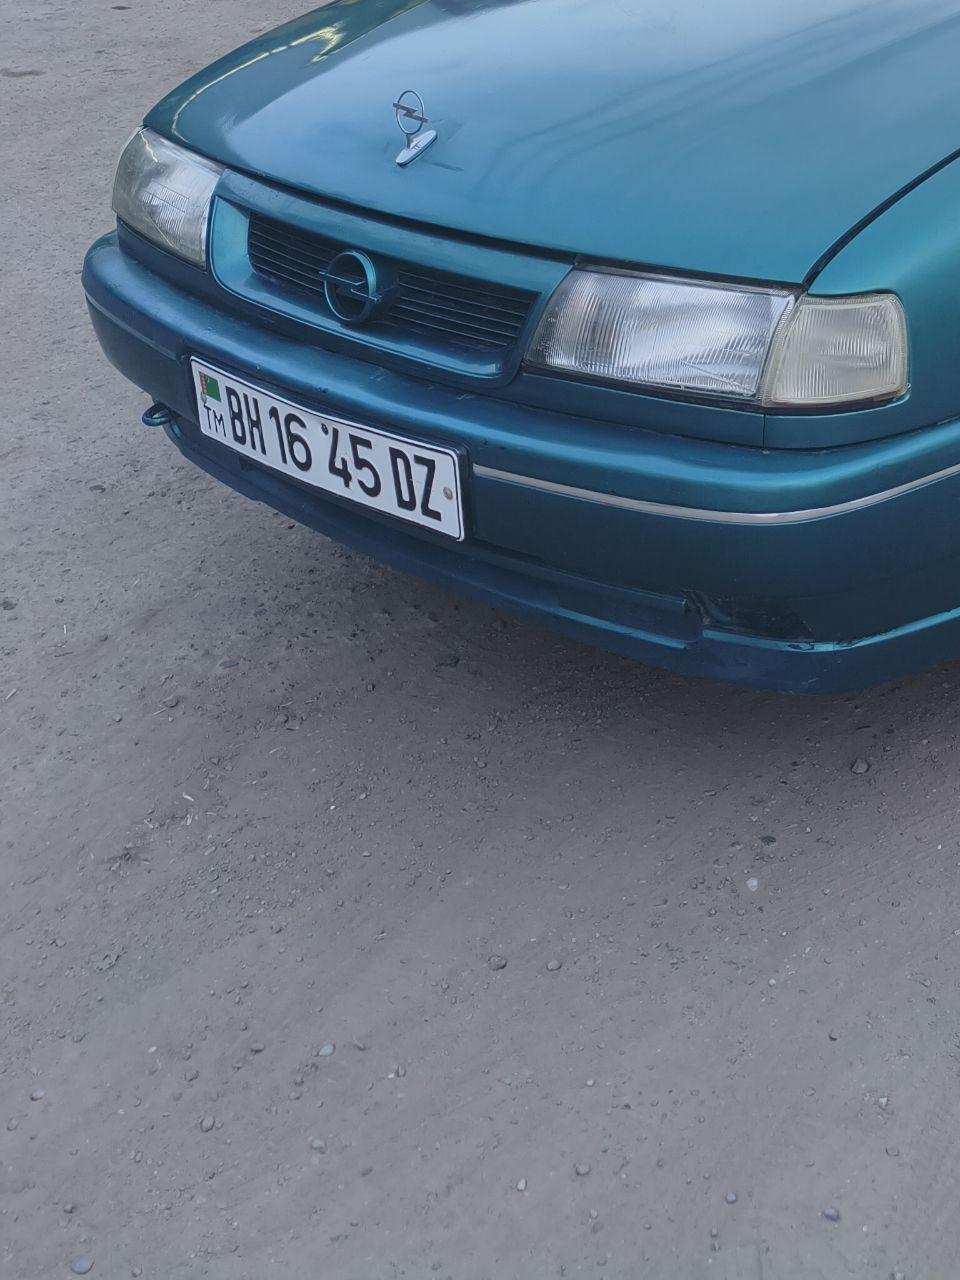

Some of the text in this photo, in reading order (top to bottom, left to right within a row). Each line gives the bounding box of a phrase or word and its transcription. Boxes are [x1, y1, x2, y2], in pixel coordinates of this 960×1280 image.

[203, 404, 226, 437] TM
[225, 386, 442, 522] BH 16 45 DZ
